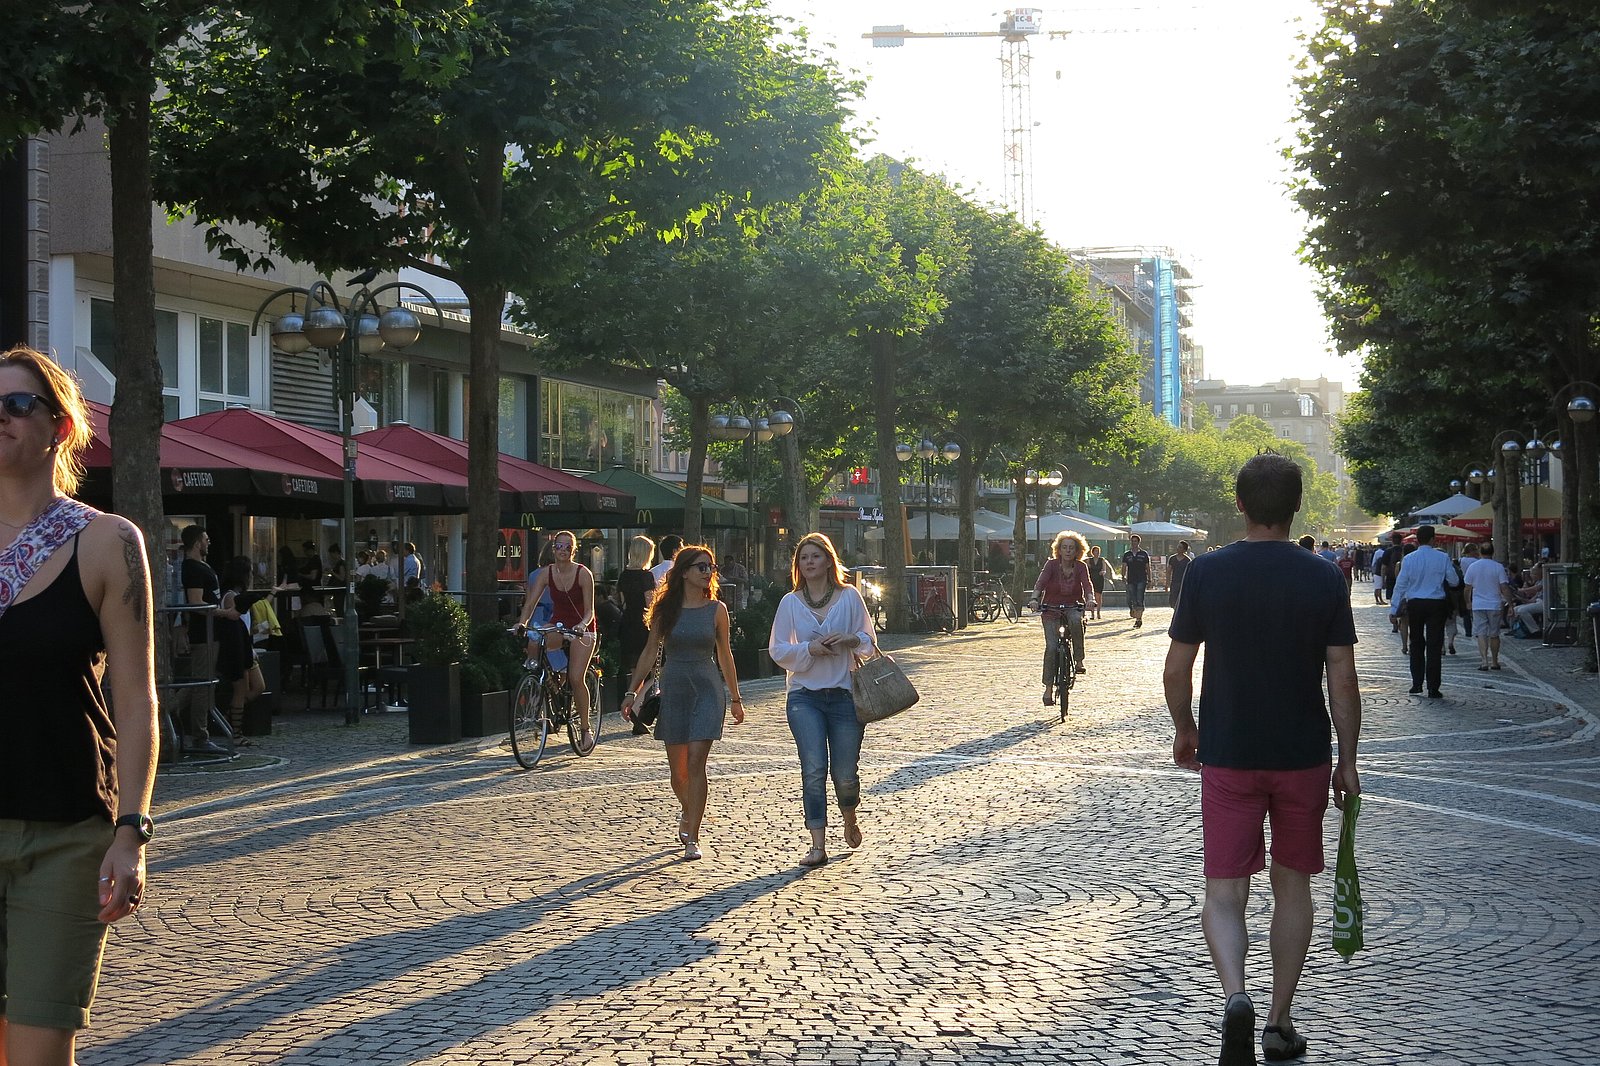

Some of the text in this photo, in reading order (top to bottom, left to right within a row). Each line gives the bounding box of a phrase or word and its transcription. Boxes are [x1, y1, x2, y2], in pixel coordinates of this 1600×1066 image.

[183, 472, 214, 487] CAFETIERO
[292, 477, 318, 494] CAFETIERO
[394, 485, 416, 498] CAFETIERO
